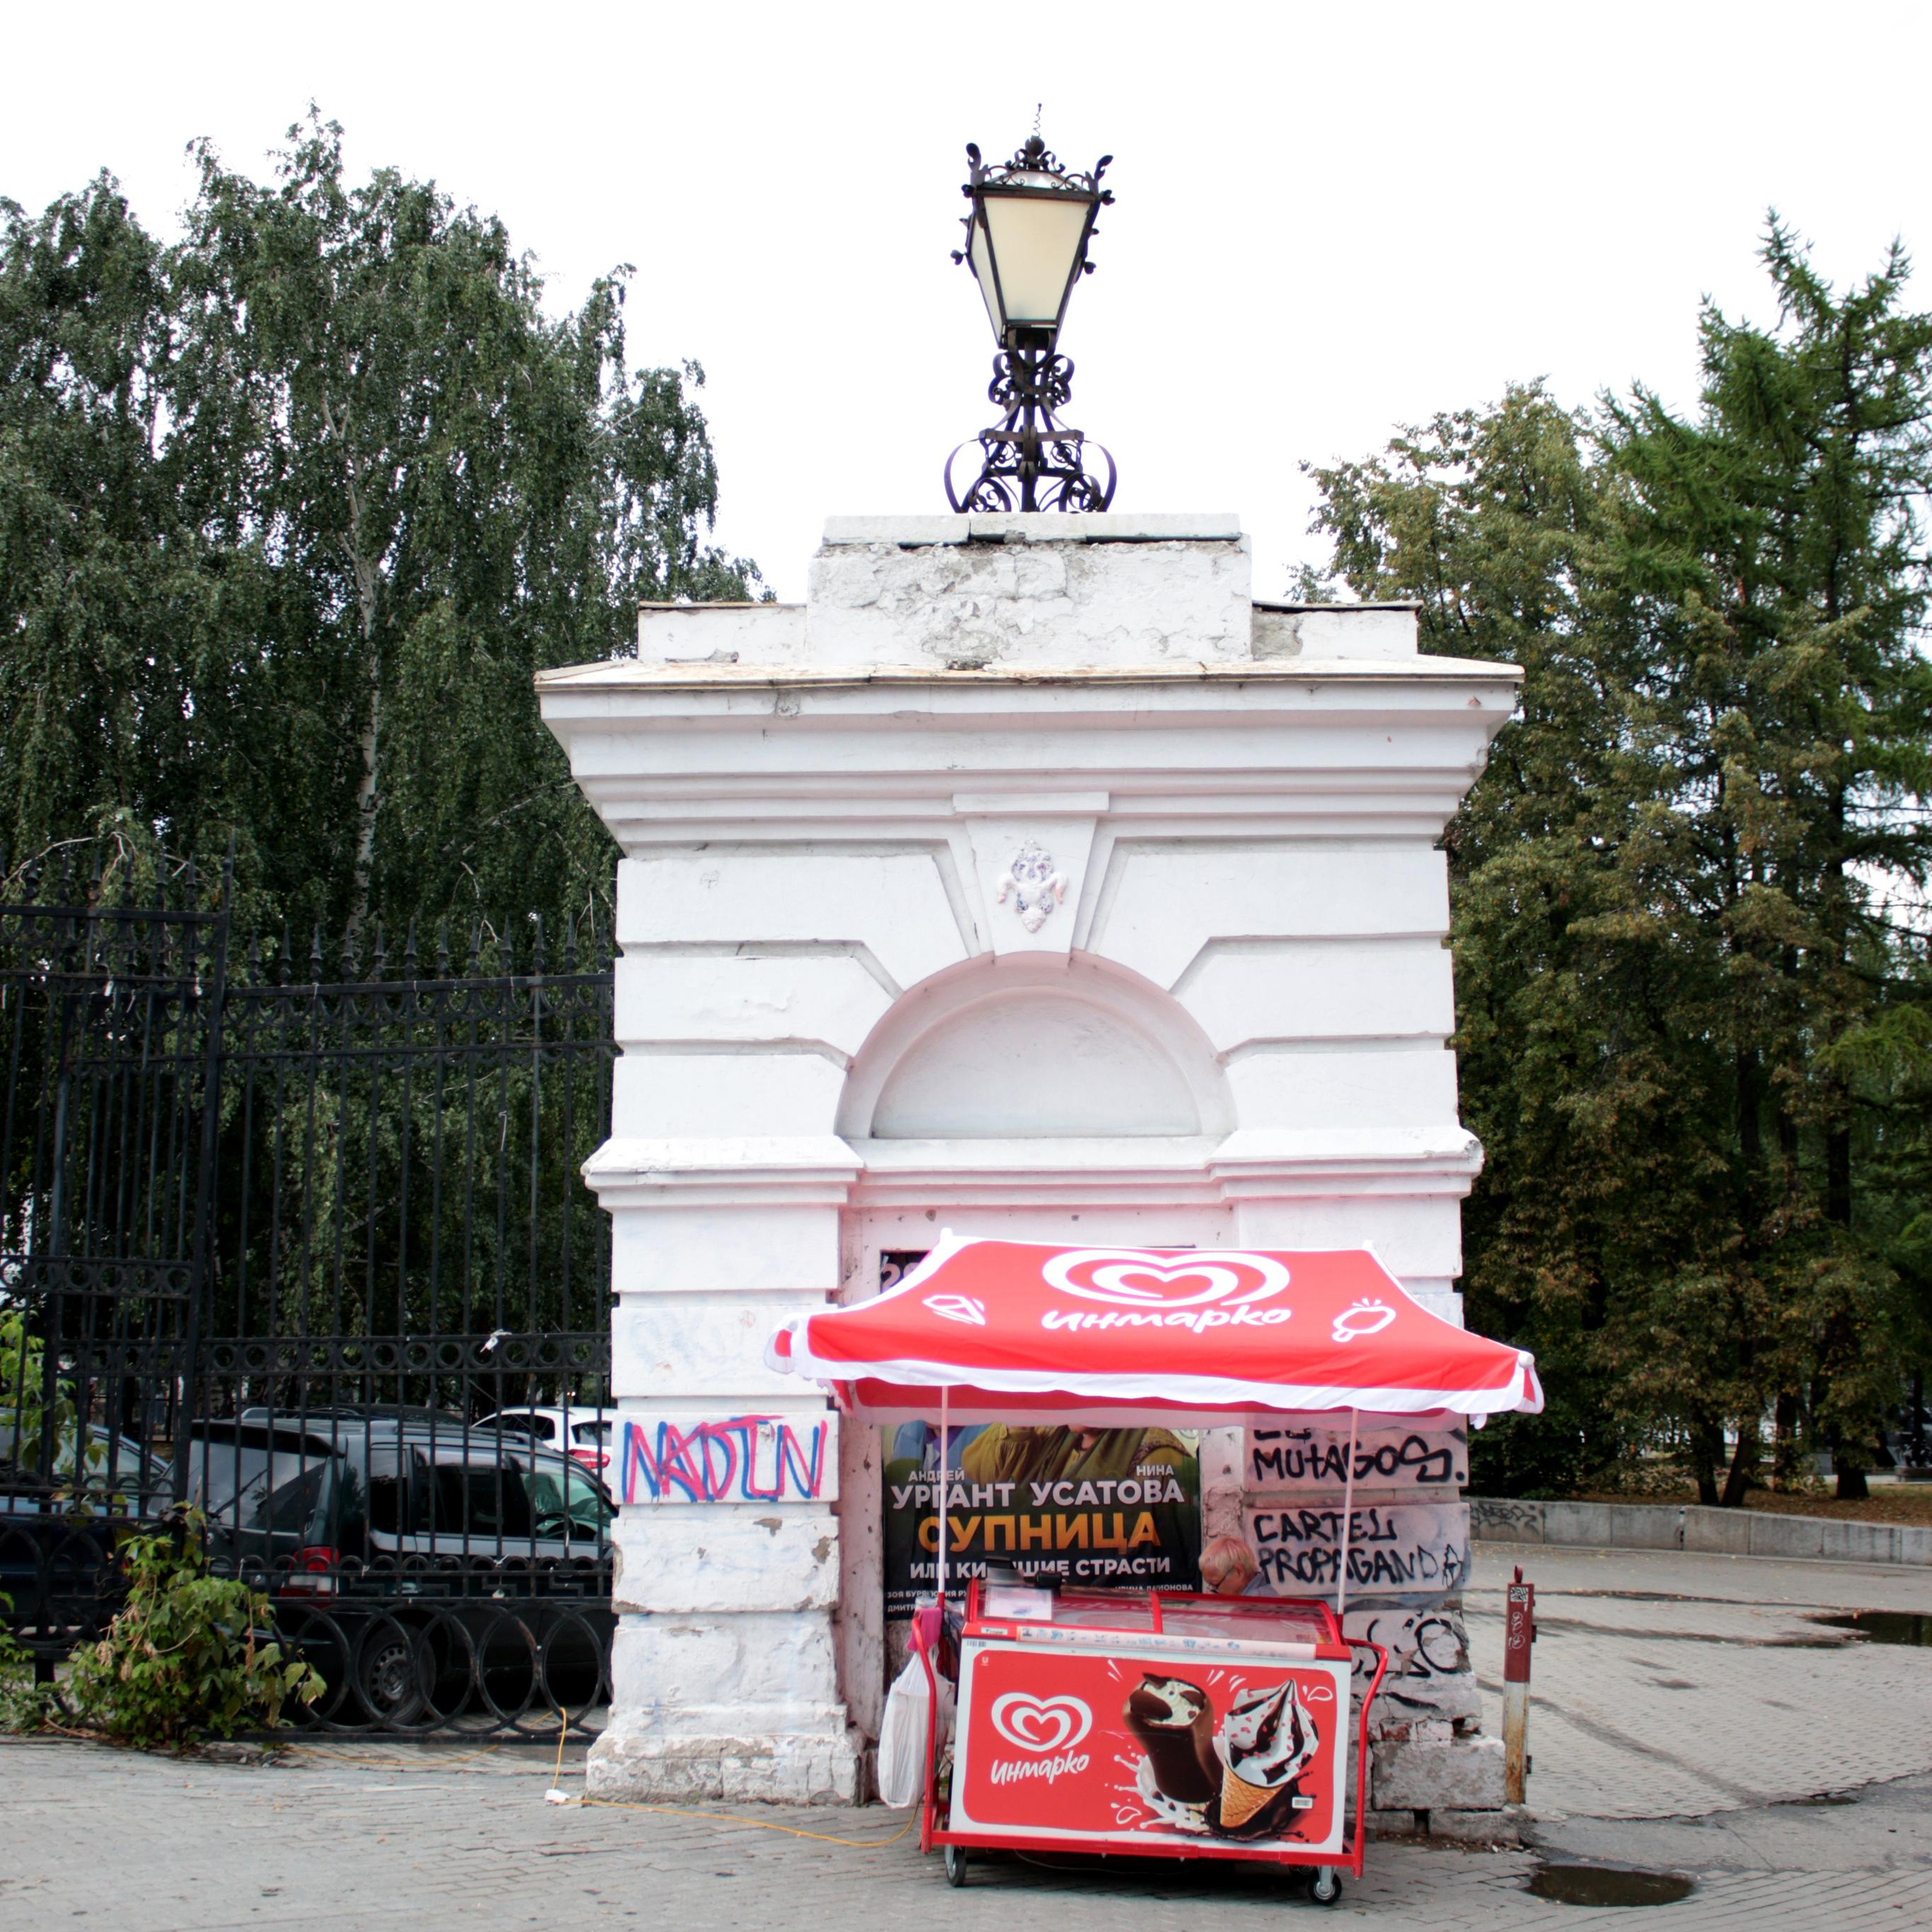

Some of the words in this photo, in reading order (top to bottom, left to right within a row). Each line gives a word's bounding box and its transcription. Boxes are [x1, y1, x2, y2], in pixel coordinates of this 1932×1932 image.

[1136, 1464, 1174, 1477] НИНА
[891, 1483, 1015, 1509] УРГАНТ
[1030, 1478, 1185, 1507] УСАТОВА
[918, 1512, 1161, 1555] СУПНИЦА
[1254, 1508, 1398, 1543] CARTEL
[910, 1562, 949, 1579] ИЛИ
[1075, 1557, 1171, 1576] СТРАСТИ
[1259, 1543, 1463, 1590] PROPAGANDA
